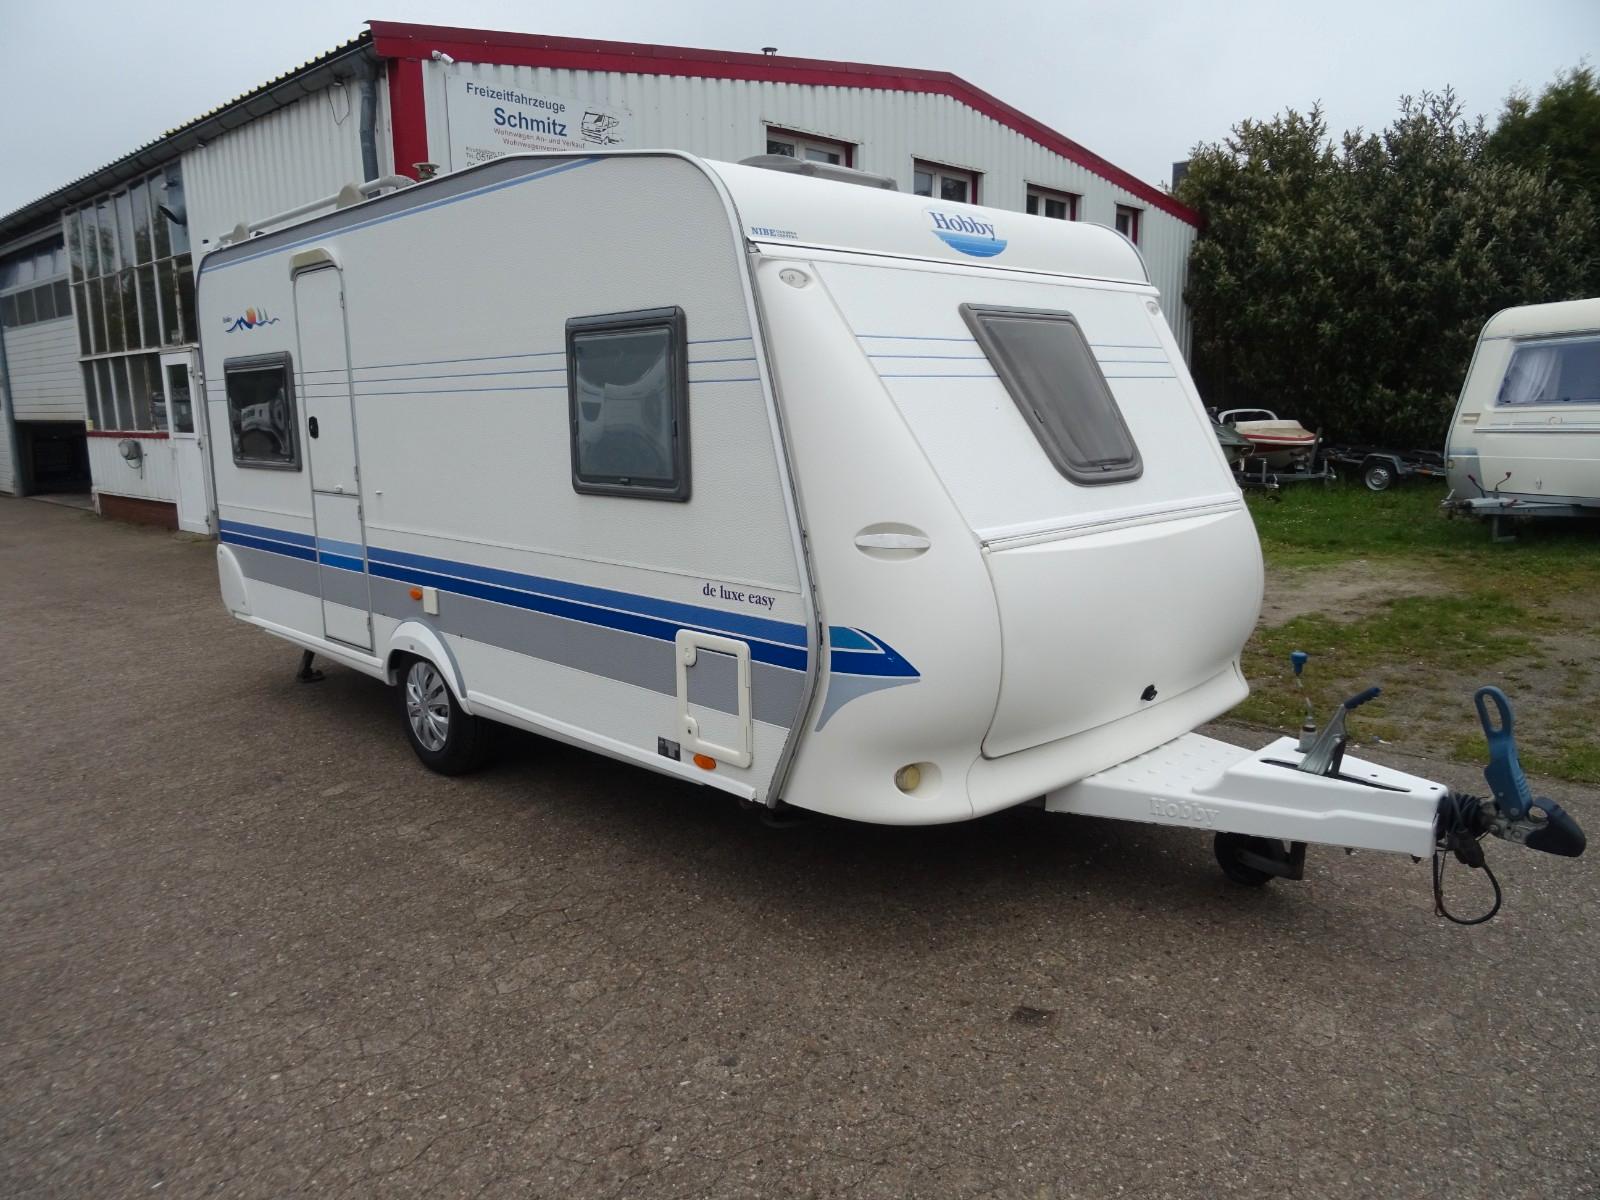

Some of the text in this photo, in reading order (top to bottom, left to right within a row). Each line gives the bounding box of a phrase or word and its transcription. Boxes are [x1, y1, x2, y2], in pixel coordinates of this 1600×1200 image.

[466, 82, 566, 113] Freizeitfahrzeuge
[494, 107, 567, 137] Schmitz
[493, 128, 534, 141] Wohnwagen
[548, 136, 561, 145] und
[562, 139, 586, 149] Verkauf
[751, 226, 777, 237] NIBE
[928, 211, 995, 242] Hobby
[702, 582, 776, 611] de luxe easy
[1148, 796, 1221, 827] Hobby
